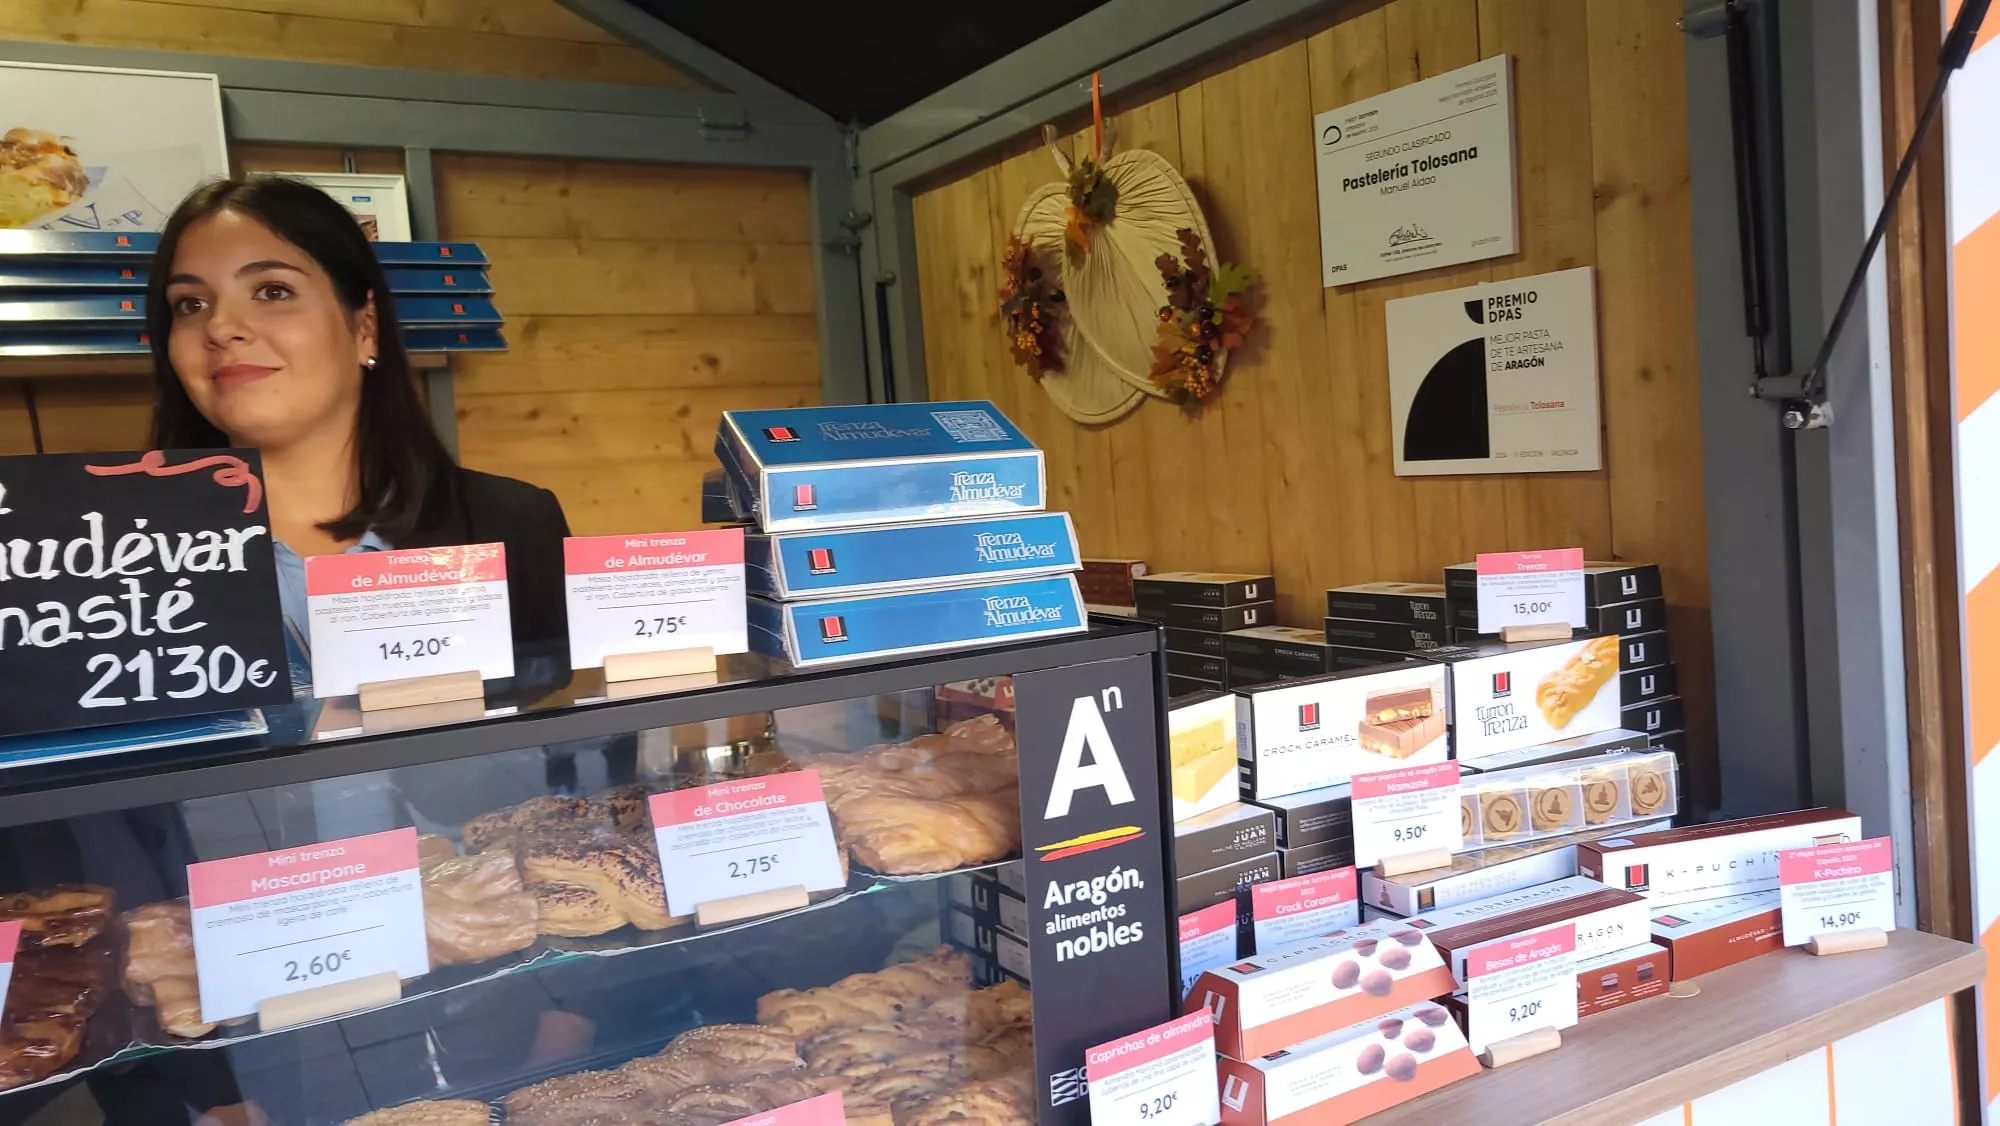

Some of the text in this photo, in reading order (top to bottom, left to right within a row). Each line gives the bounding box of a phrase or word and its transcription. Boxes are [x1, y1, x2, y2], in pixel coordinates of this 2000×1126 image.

[1365, 131, 1452, 162] SEGUNDO CLASIFICADO
[1343, 146, 1478, 192] Pastelería Tolosana
[1380, 180, 1410, 195] Manuel
[1488, 291, 1538, 310] PREMIO
[1489, 307, 1522, 323] DPAS
[1490, 329, 1550, 345] MEJOR PASTA
[1490, 348, 1503, 359] DE
[1517, 341, 1564, 355] ARTESANA
[1491, 357, 1545, 371] DE ARAGÓN
[818, 421, 883, 434] Trenza
[950, 471, 996, 486] Trenza
[950, 483, 1026, 501] Almudévar
[625, 537, 687, 548] Mini trenza
[974, 532, 1023, 547] Trenza
[605, 551, 708, 569] de Almudévar
[975, 542, 1056, 562] Almudévar
[1517, 563, 1547, 571] Trenza
[351, 576, 373, 589] de
[983, 596, 1030, 611] Trenza
[1513, 602, 1552, 615] 15,00€
[984, 605, 1062, 626] Almudévar
[634, 616, 687, 638] 2,75€
[378, 636, 450, 661] 14,20€
[1481, 715, 1528, 736] Trenza
[1263, 734, 1357, 757] CROCK CARAMEL
[707, 781, 766, 798] Mini trenza
[1387, 778, 1429, 792] Namasté
[694, 793, 786, 817] de Chocolate
[1233, 829, 1266, 843] JUAN
[1394, 825, 1427, 842] 9,50€
[268, 846, 346, 867] Mini trenza
[728, 854, 780, 879] 2,75€
[1814, 866, 1862, 879] K-Puchino
[251, 862, 366, 893] Mascarpone
[1237, 871, 1270, 885] JUAN
[1043, 865, 1145, 910] Aragón,
[1276, 893, 1339, 914] Crock Caramel
[1045, 902, 1126, 935] alimentos
[1820, 912, 1861, 928] 14,90€
[1056, 920, 1144, 962] nobles
[283, 950, 352, 982] 2,60€
[1485, 943, 1562, 971] Besos de Aragón
[1509, 1000, 1542, 1022] 9,20€
[1090, 1015, 1211, 1065] Caprichos de almendra
[1140, 1091, 1178, 1119] 9,20€
